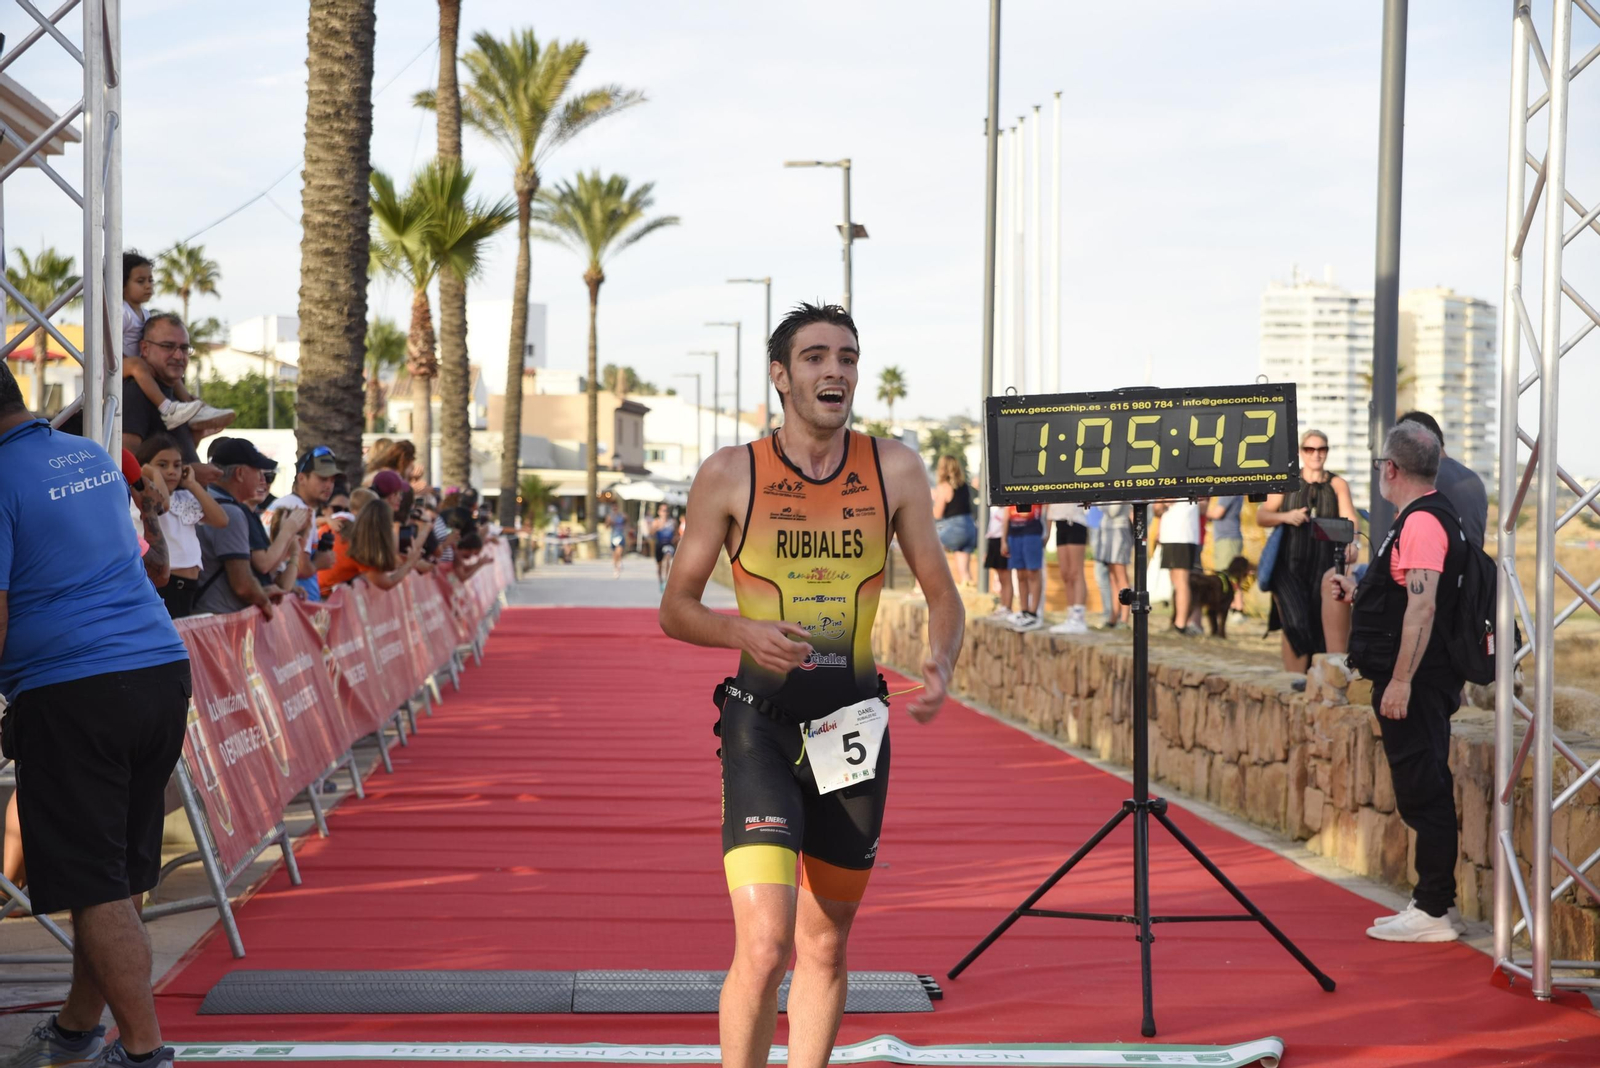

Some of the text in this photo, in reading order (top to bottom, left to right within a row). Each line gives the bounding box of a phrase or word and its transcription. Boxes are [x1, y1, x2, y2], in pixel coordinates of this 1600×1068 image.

[1001, 396, 1284, 415] www.gesconchip.es 615 980 784 info@gesconchip.es
[1037, 410, 1276, 476] 1:05:42
[48, 449, 96, 469] OFICIAL
[48, 470, 120, 501] triatlón
[1005, 481, 1105, 492] www.gesconchip.es
[1113, 480, 1133, 488] 615
[1136, 479, 1155, 487] 980
[1186, 474, 1288, 484] info@gesconchip.es
[776, 529, 863, 559] RUBIALES
[842, 731, 867, 765] 5
[765, 815, 787, 824] ENERGY
[392, 1048, 606, 1056] FEDERACION
[867, 1044, 1025, 1059] TRIATLON
